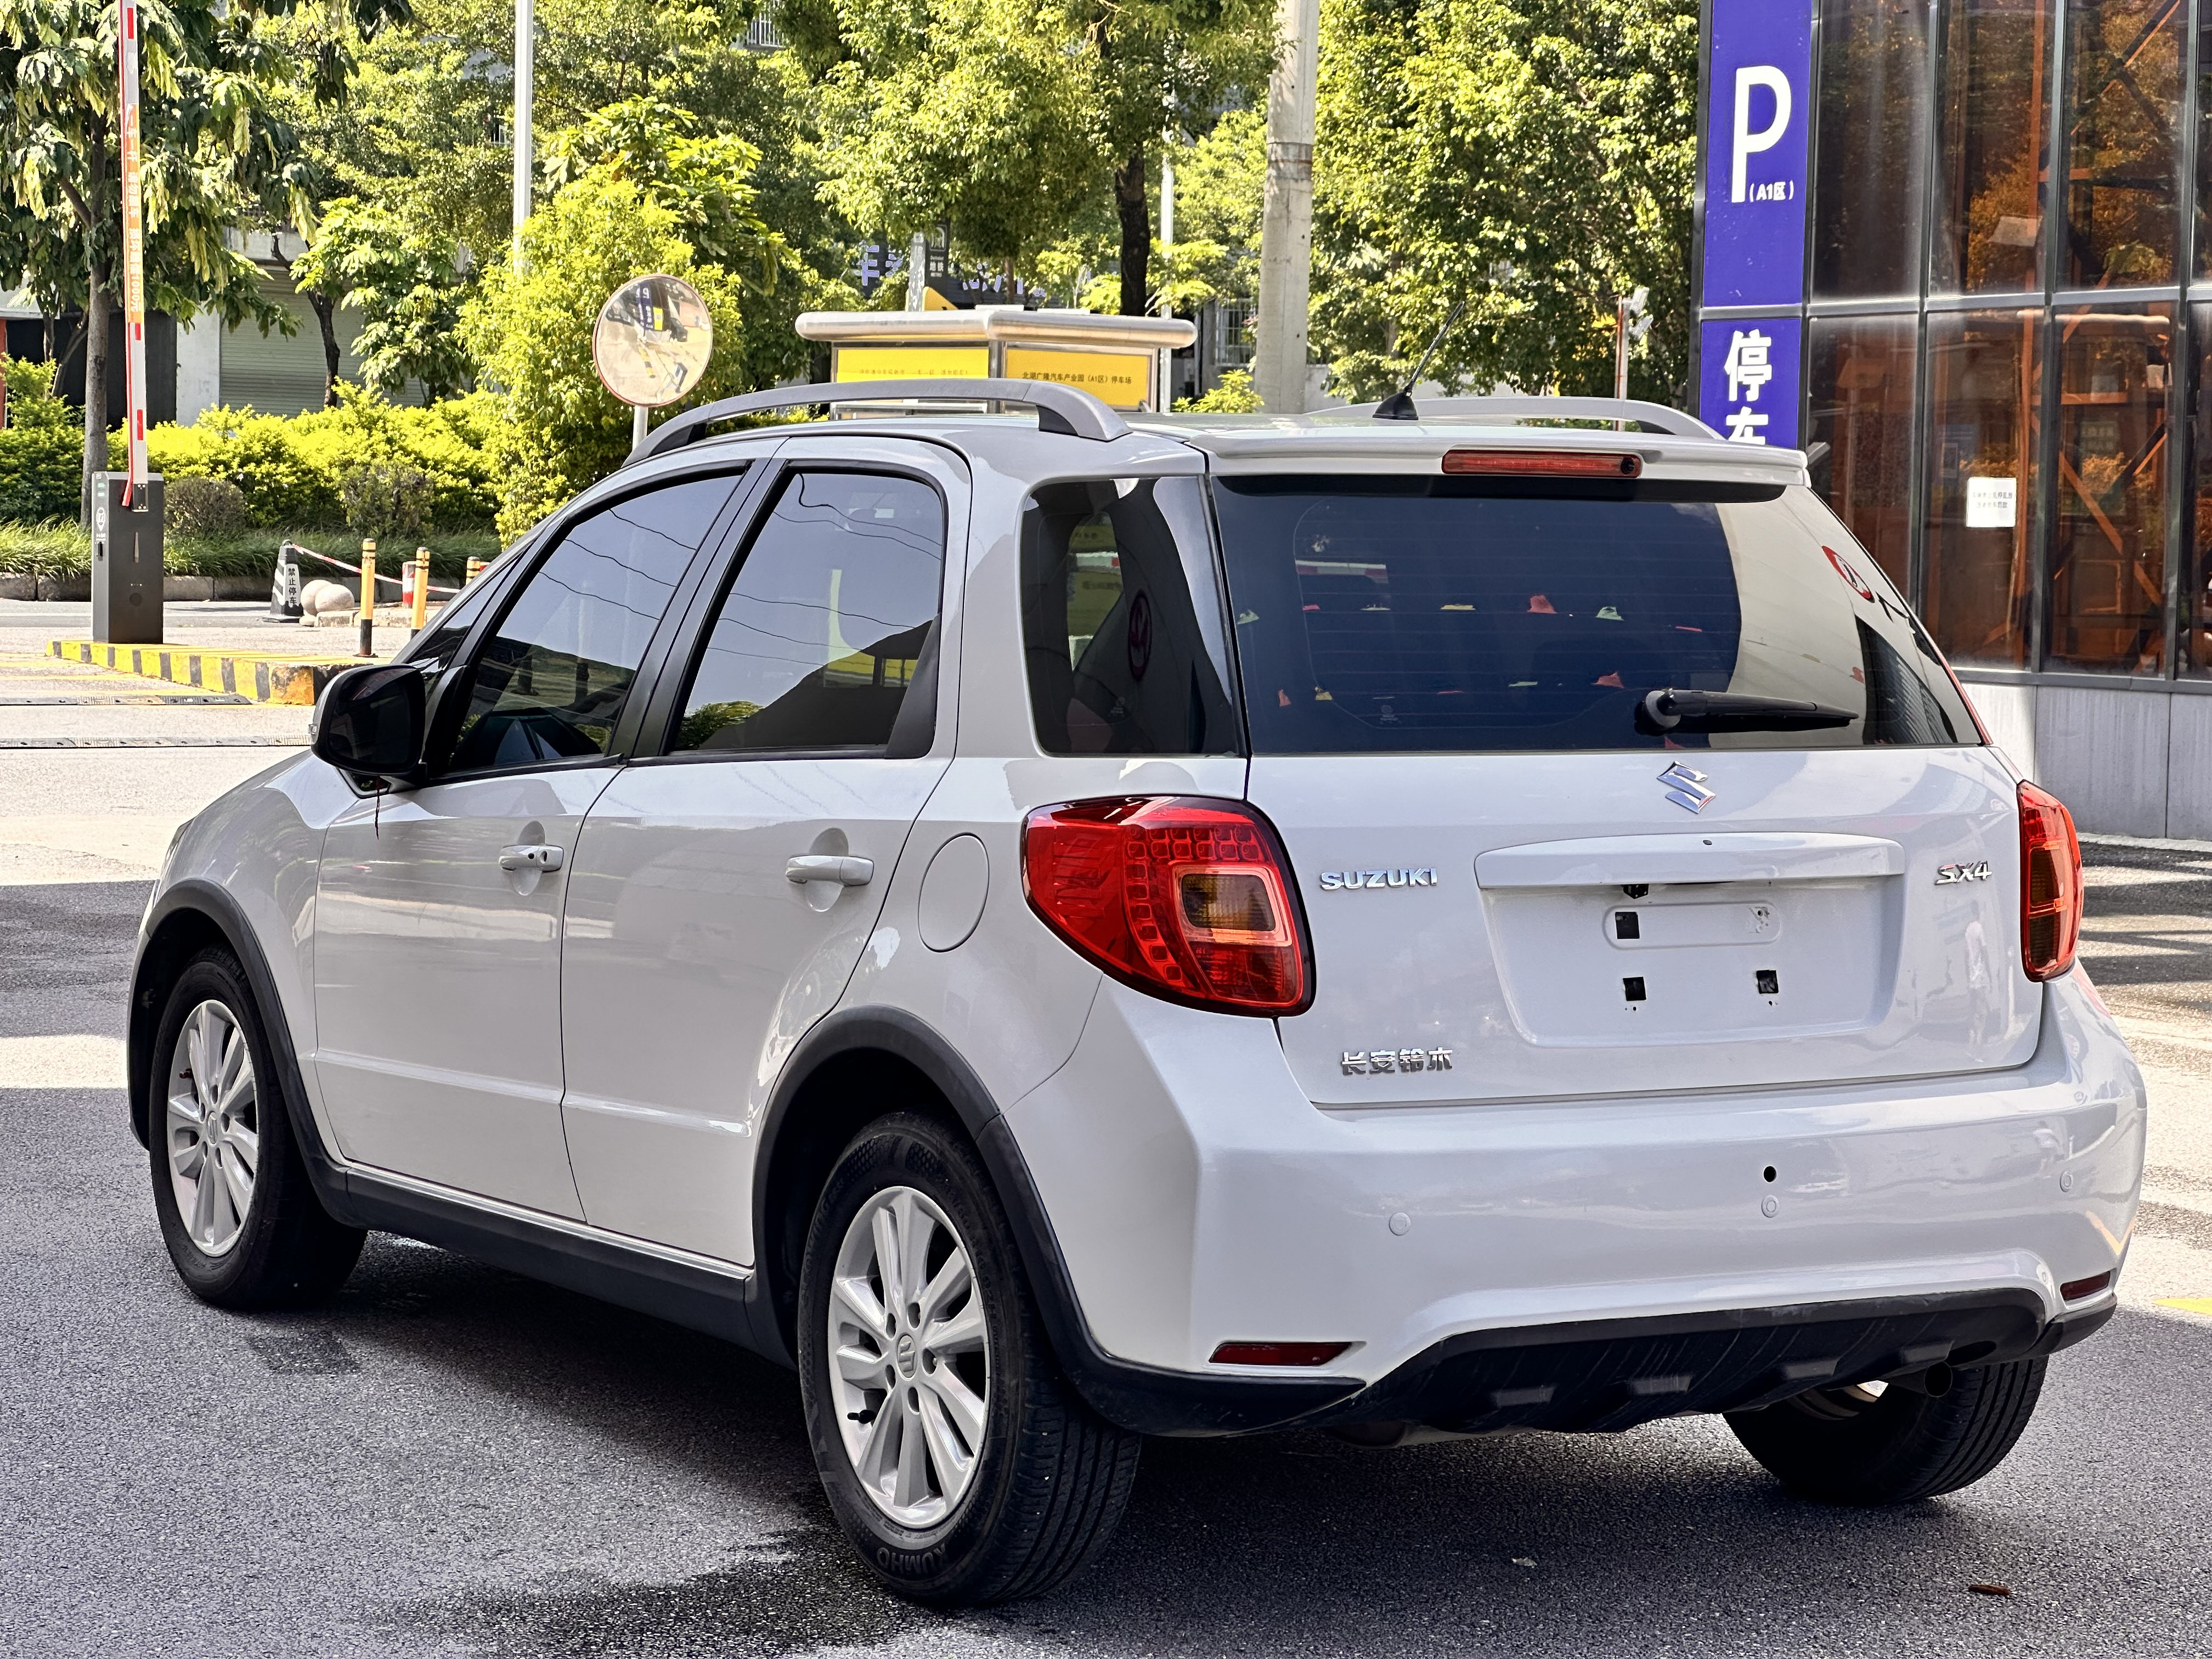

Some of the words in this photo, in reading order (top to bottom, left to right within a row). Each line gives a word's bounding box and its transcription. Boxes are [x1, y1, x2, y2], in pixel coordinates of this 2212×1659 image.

[1731, 65, 1792, 203] P
[288, 567, 297, 605] 禁止停车
[1320, 867, 1438, 890] SUZUKI
[1934, 860, 1993, 885] SX4
[1341, 1047, 1453, 1076] 长安铃木
[877, 1543, 946, 1575] KUMHO
